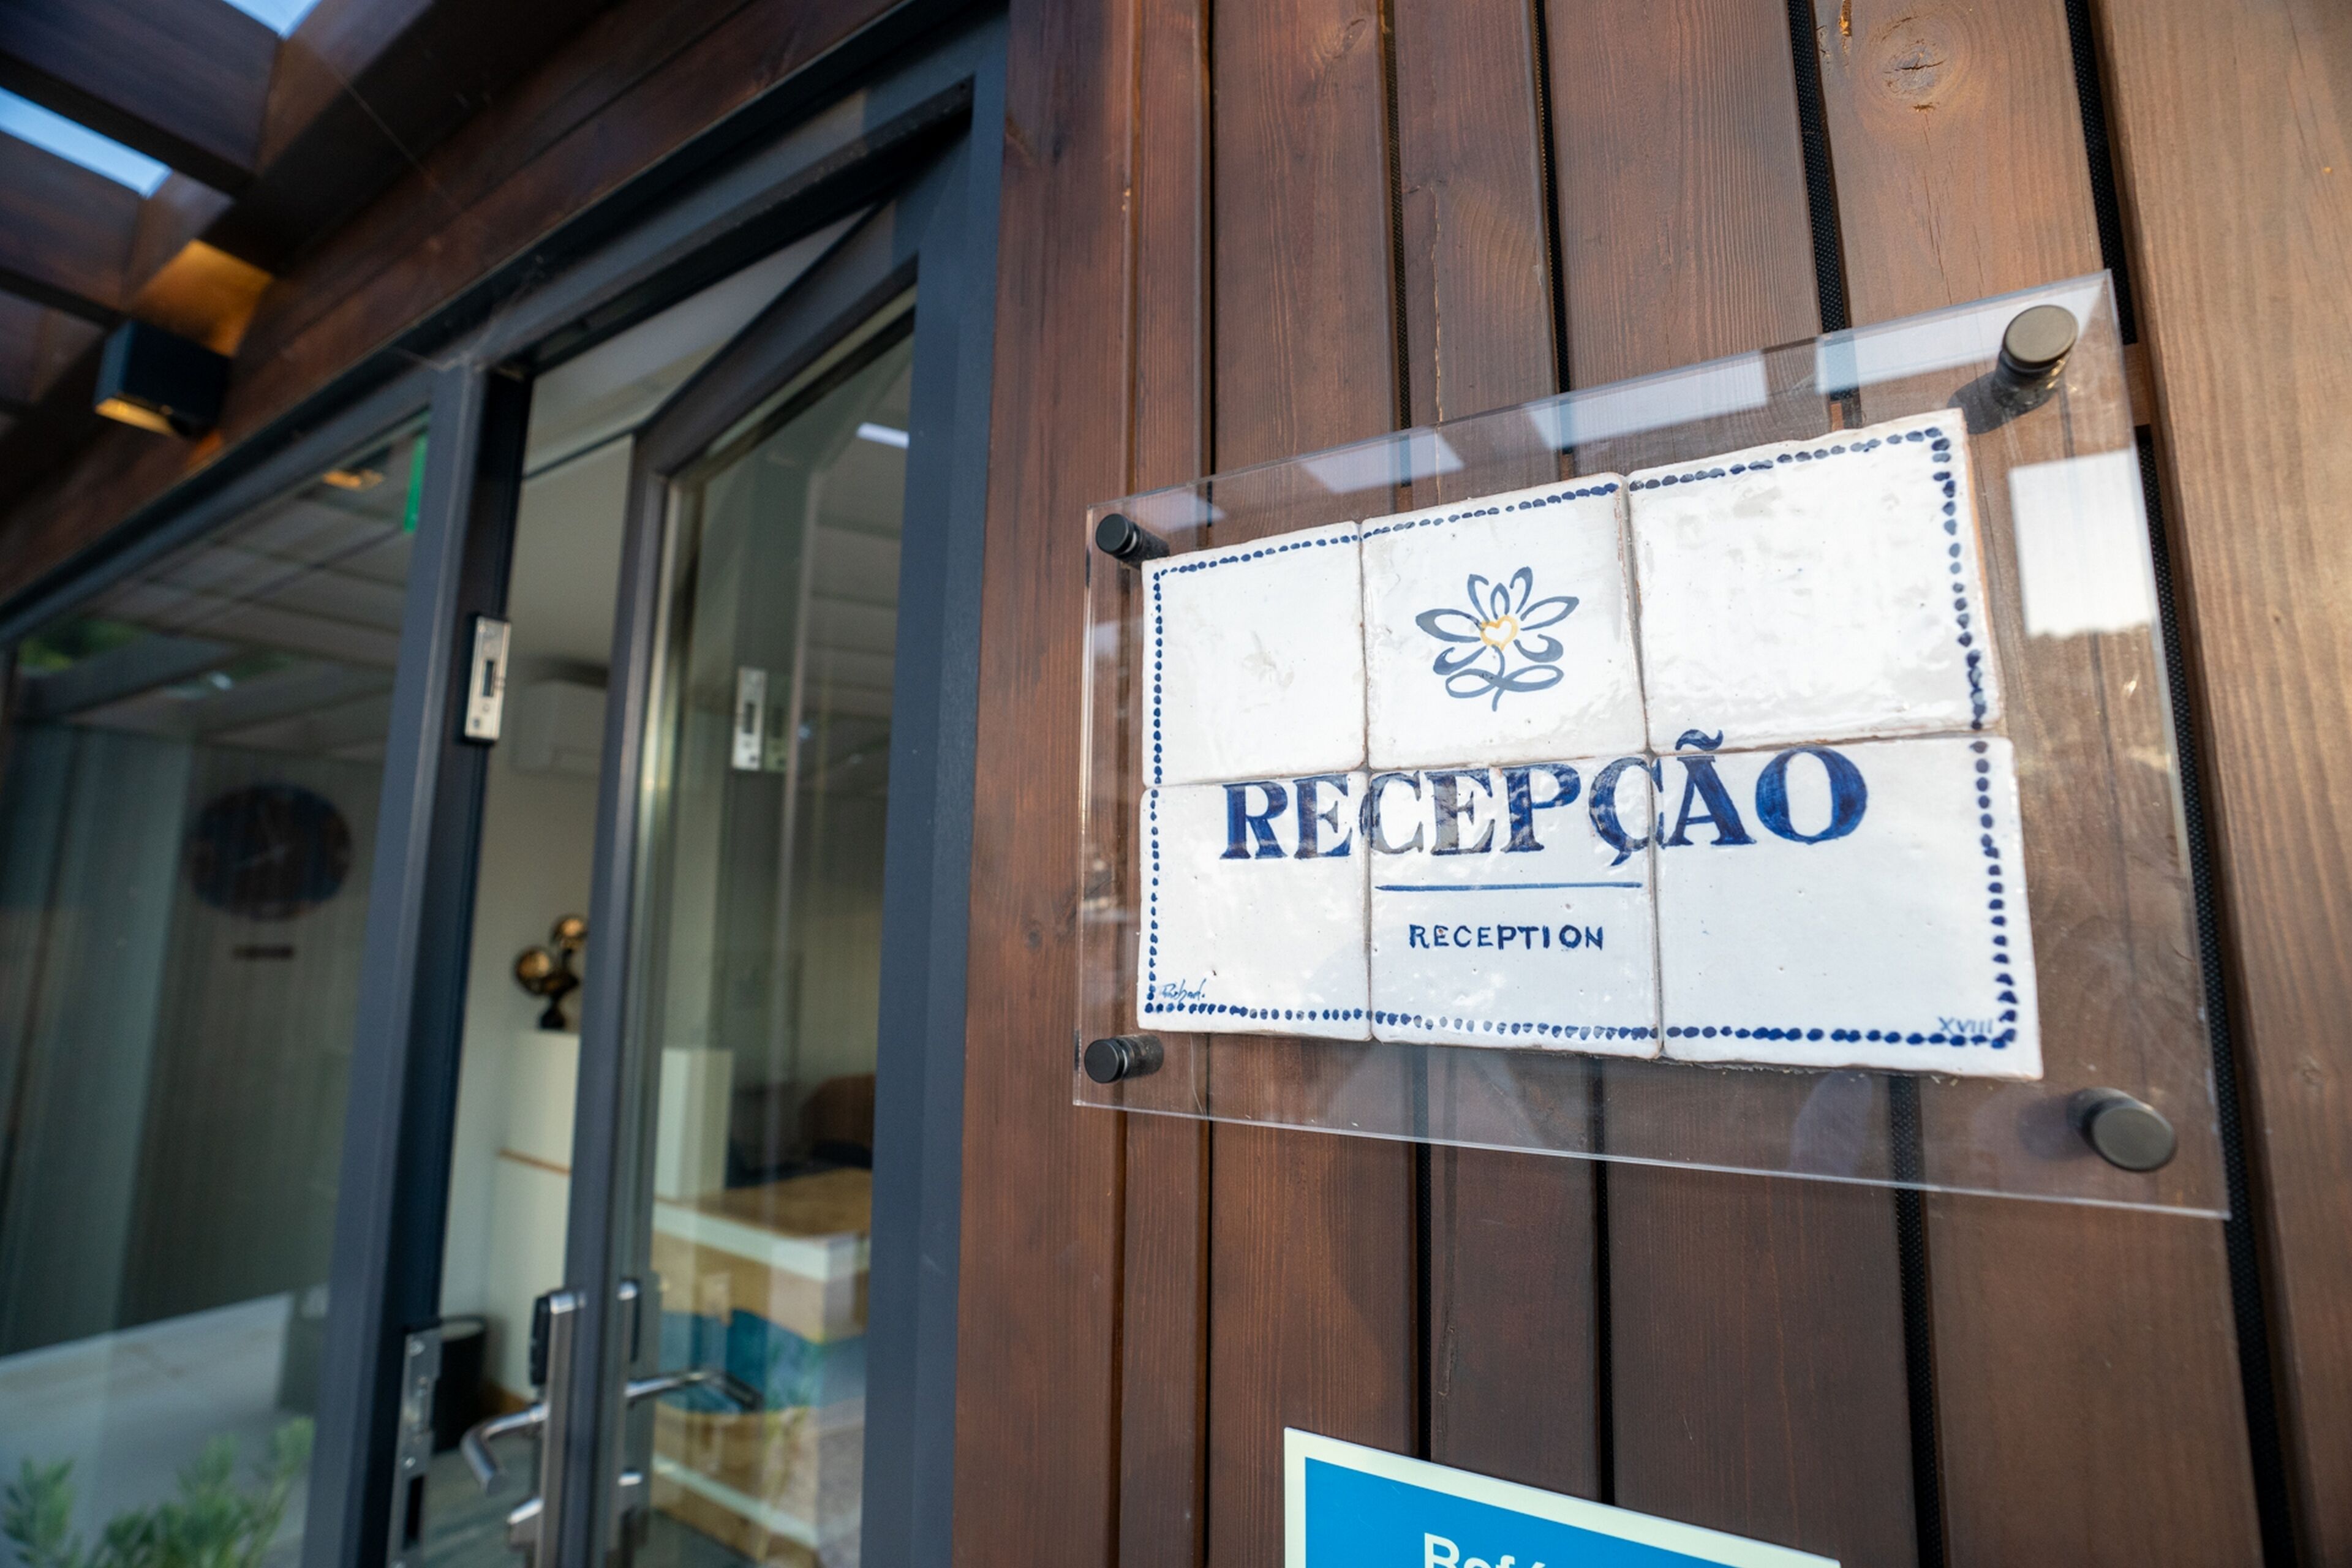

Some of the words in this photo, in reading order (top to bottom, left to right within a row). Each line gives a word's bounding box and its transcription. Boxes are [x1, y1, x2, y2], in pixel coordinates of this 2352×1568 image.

[1220, 729, 1868, 866] RECEPÇÃO
[1409, 924, 1604, 950] RECEPTION
[1938, 1016, 1993, 1036] XVIII
